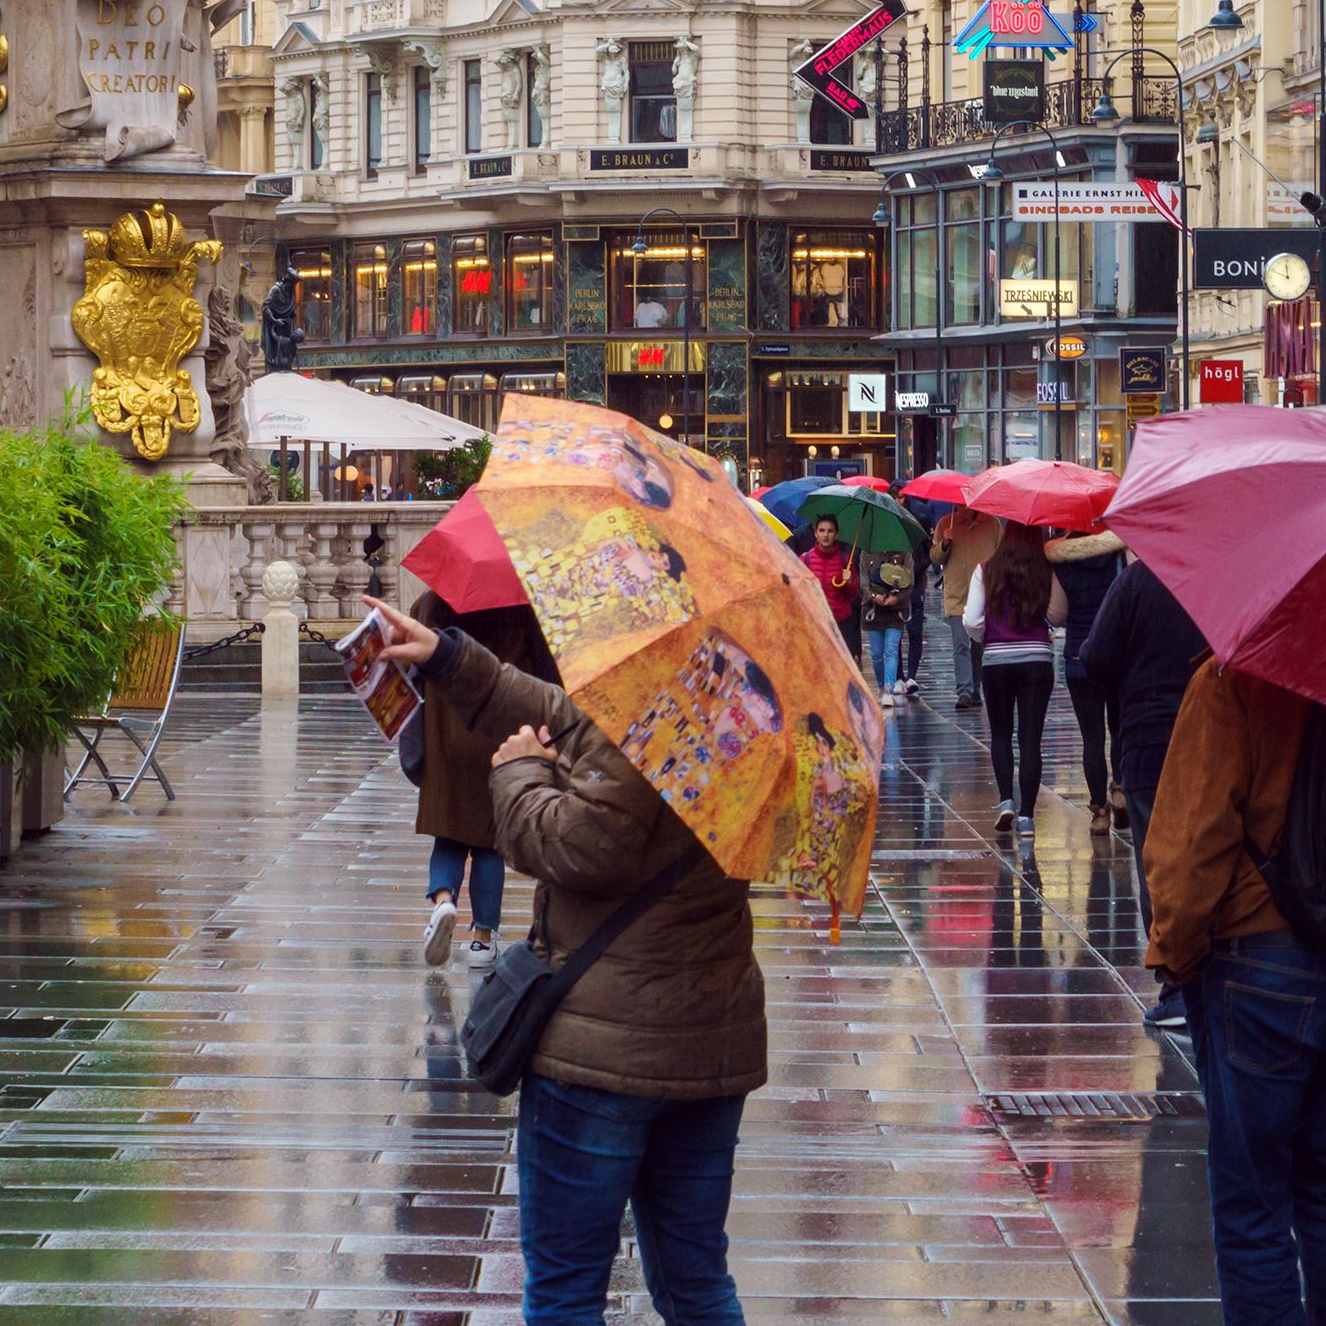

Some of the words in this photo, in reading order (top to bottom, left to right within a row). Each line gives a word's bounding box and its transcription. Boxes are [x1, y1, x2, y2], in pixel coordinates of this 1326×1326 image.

[97, 0, 165, 26] DEO
[991, 1, 1043, 34] Köö
[88, 38, 171, 60] PATRI
[814, 11, 893, 76] FLEDERMAUS
[86, 73, 176, 93] CREATORI
[827, 81, 848, 102] BAR
[615, 154, 651, 165] BRAUN
[833, 155, 867, 167] BRAUN
[1032, 189, 1081, 198] GALERIE
[1085, 189, 1122, 197] ERNST
[1125, 189, 1146, 197] HIL
[1018, 206, 1105, 215] SINDBADS
[576, 290, 600, 298] BERLIN
[715, 288, 739, 296] BERLIN
[1004, 289, 1073, 303] TRZEŚNIEWSKI
[577, 315, 598, 323] PRAG
[637, 347, 665, 366] H&M
[895, 391, 929, 410] NESPRESSO
